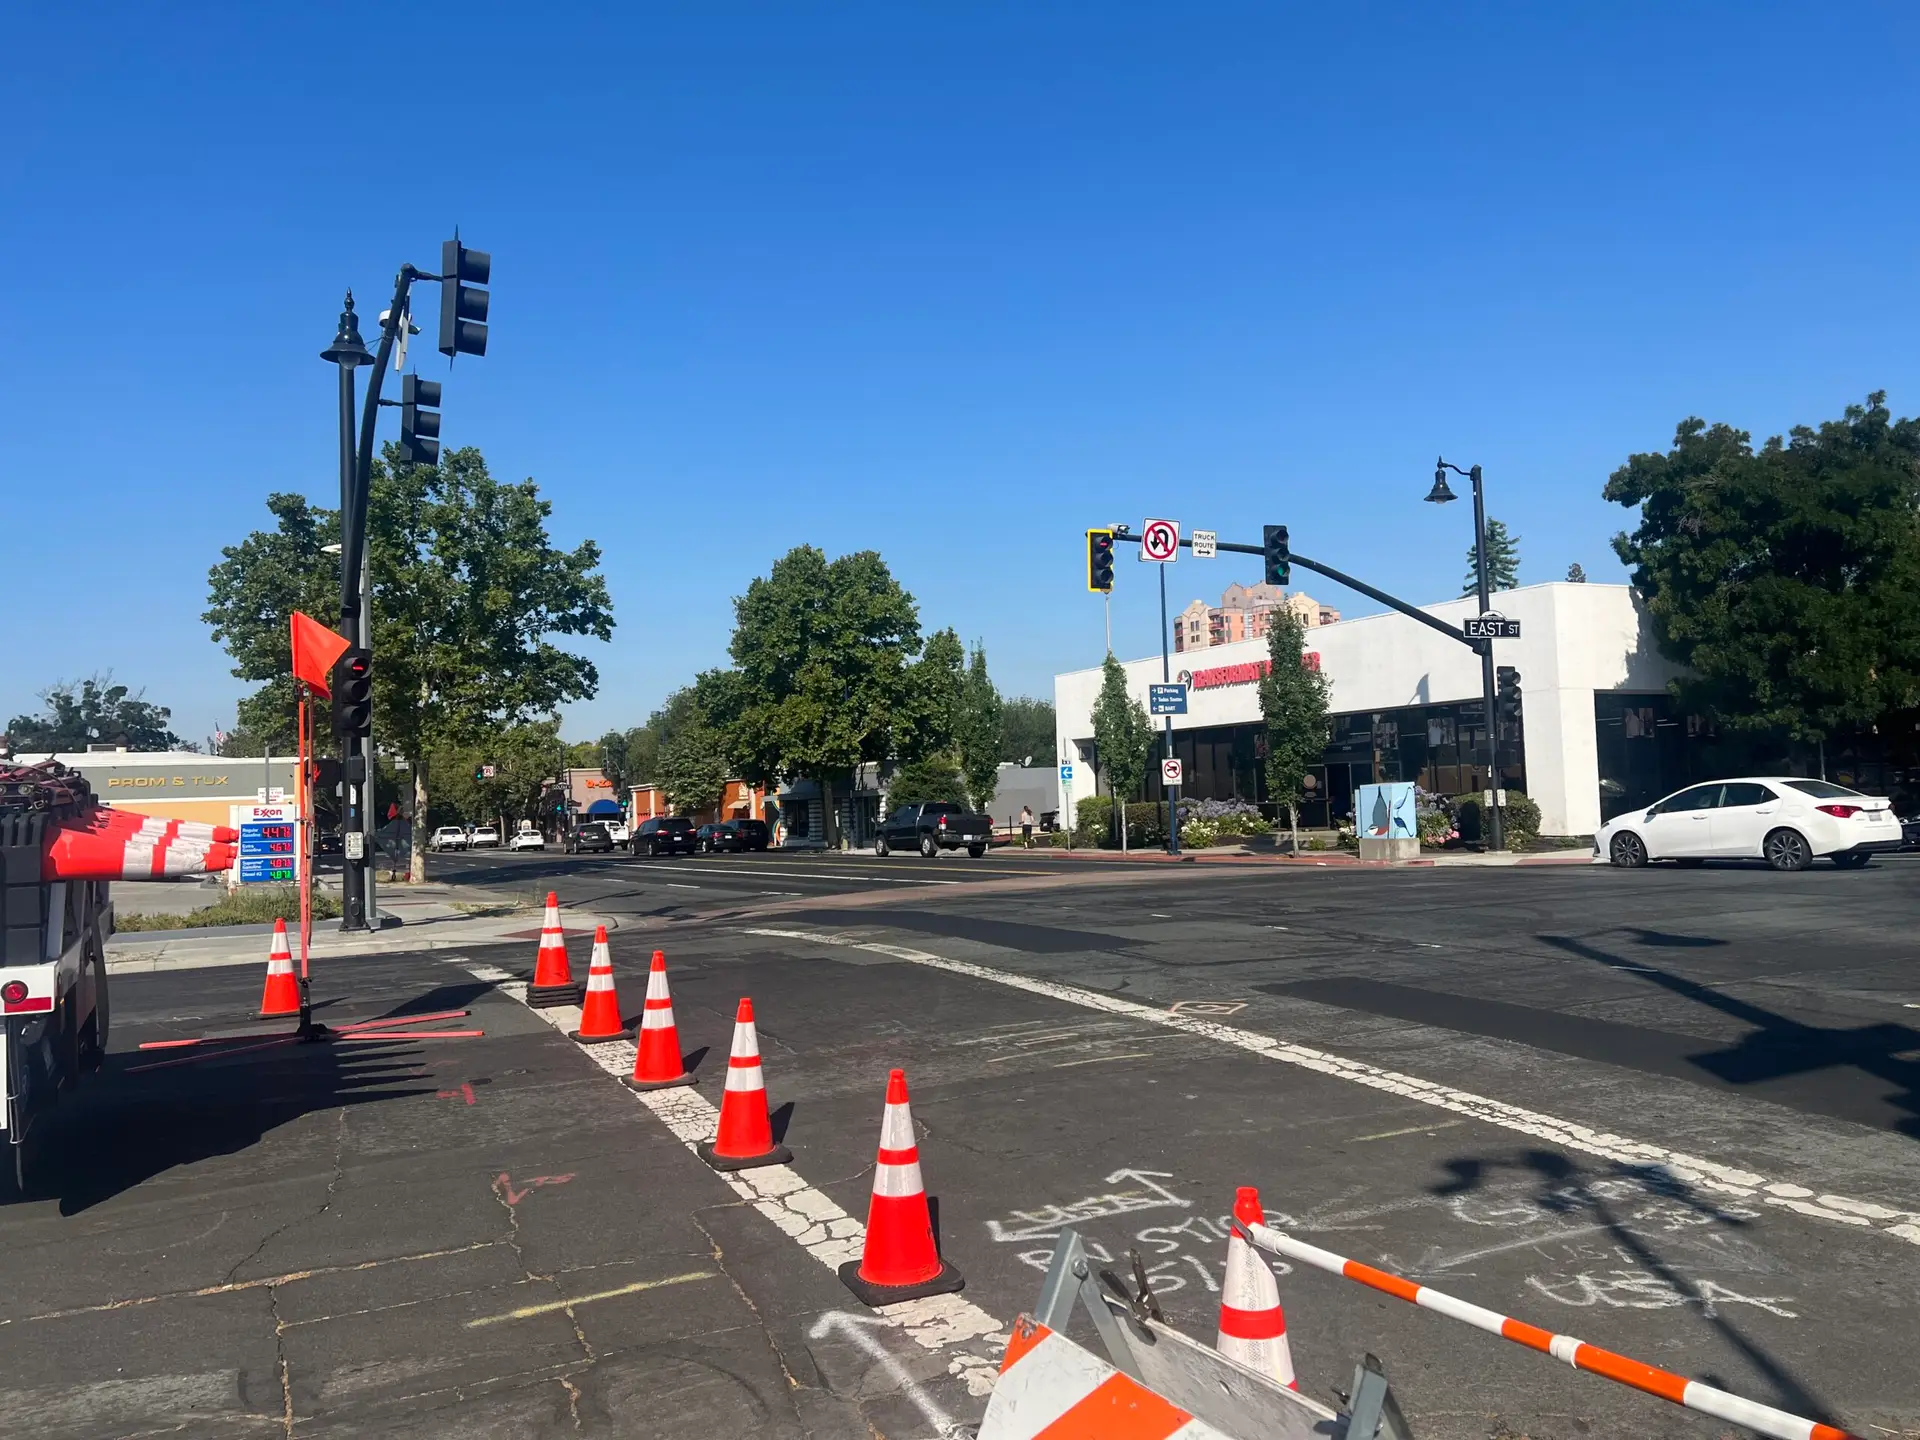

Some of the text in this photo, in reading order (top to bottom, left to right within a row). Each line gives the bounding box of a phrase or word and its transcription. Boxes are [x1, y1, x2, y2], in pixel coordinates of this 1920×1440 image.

[1194, 533, 1215, 541] TRUCK
[1470, 622, 1519, 636] EAST ST
[108, 775, 229, 787] PROM & TUX
[253, 808, 282, 817] Exxon
